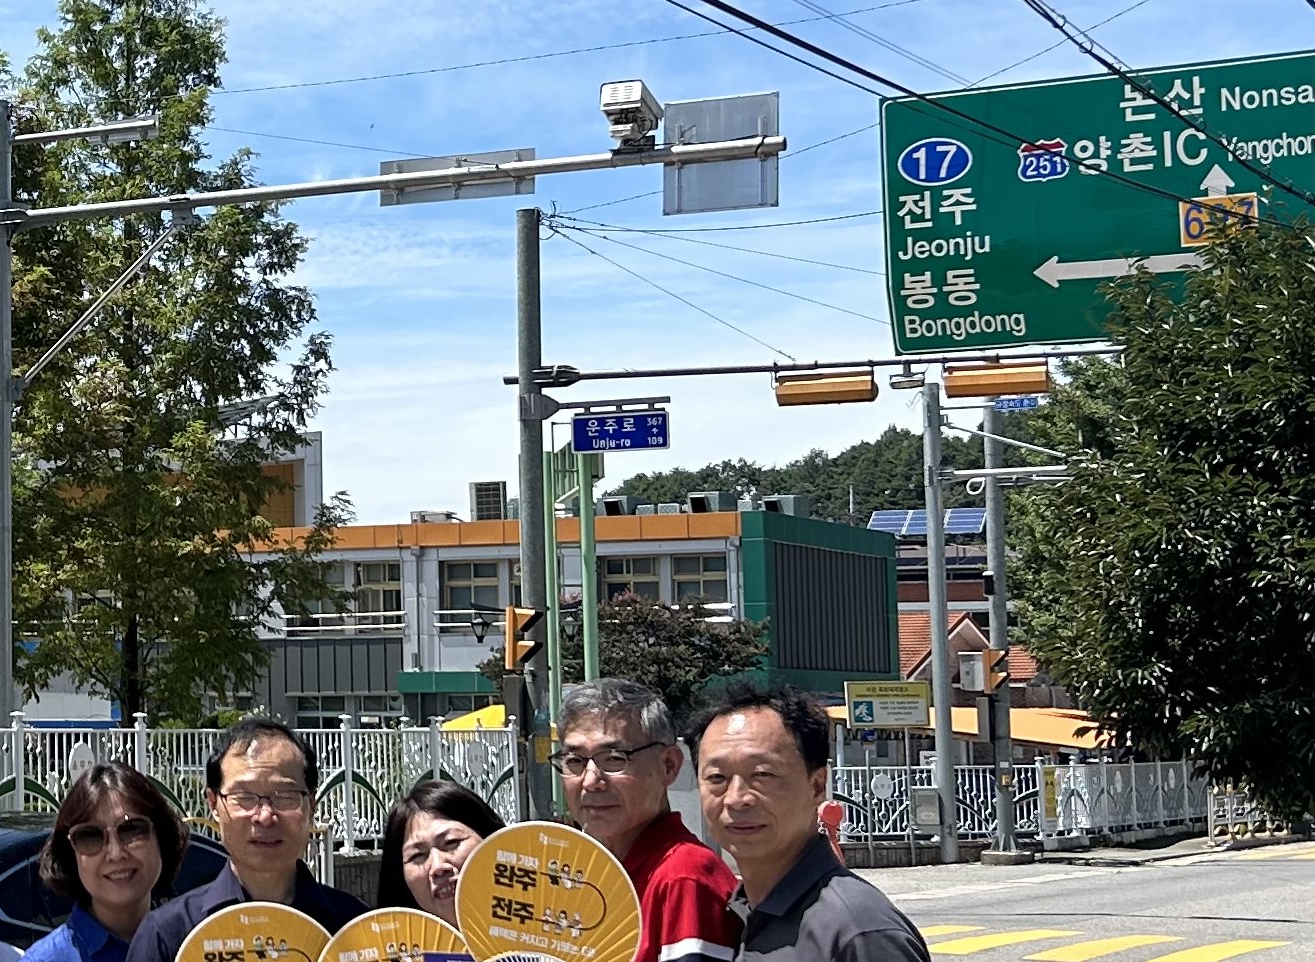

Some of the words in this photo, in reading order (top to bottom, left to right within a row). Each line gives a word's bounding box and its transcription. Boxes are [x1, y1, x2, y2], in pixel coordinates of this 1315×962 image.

[1119, 76, 1205, 122] 논산
[912, 144, 957, 180] 17
[1025, 155, 1063, 176] 251
[1073, 128, 1208, 174] 양촌IC
[897, 187, 977, 230] 전주
[898, 231, 991, 261] Jeonju
[900, 268, 981, 309] 봉동
[903, 310, 1027, 341] Bongdong
[586, 417, 636, 437] 운주로
[647, 417, 663, 426] 367
[592, 437, 631, 449] Unju-ro
[647, 436, 663, 445] 109
[493, 863, 537, 892] 완주
[491, 895, 535, 925] 전주
